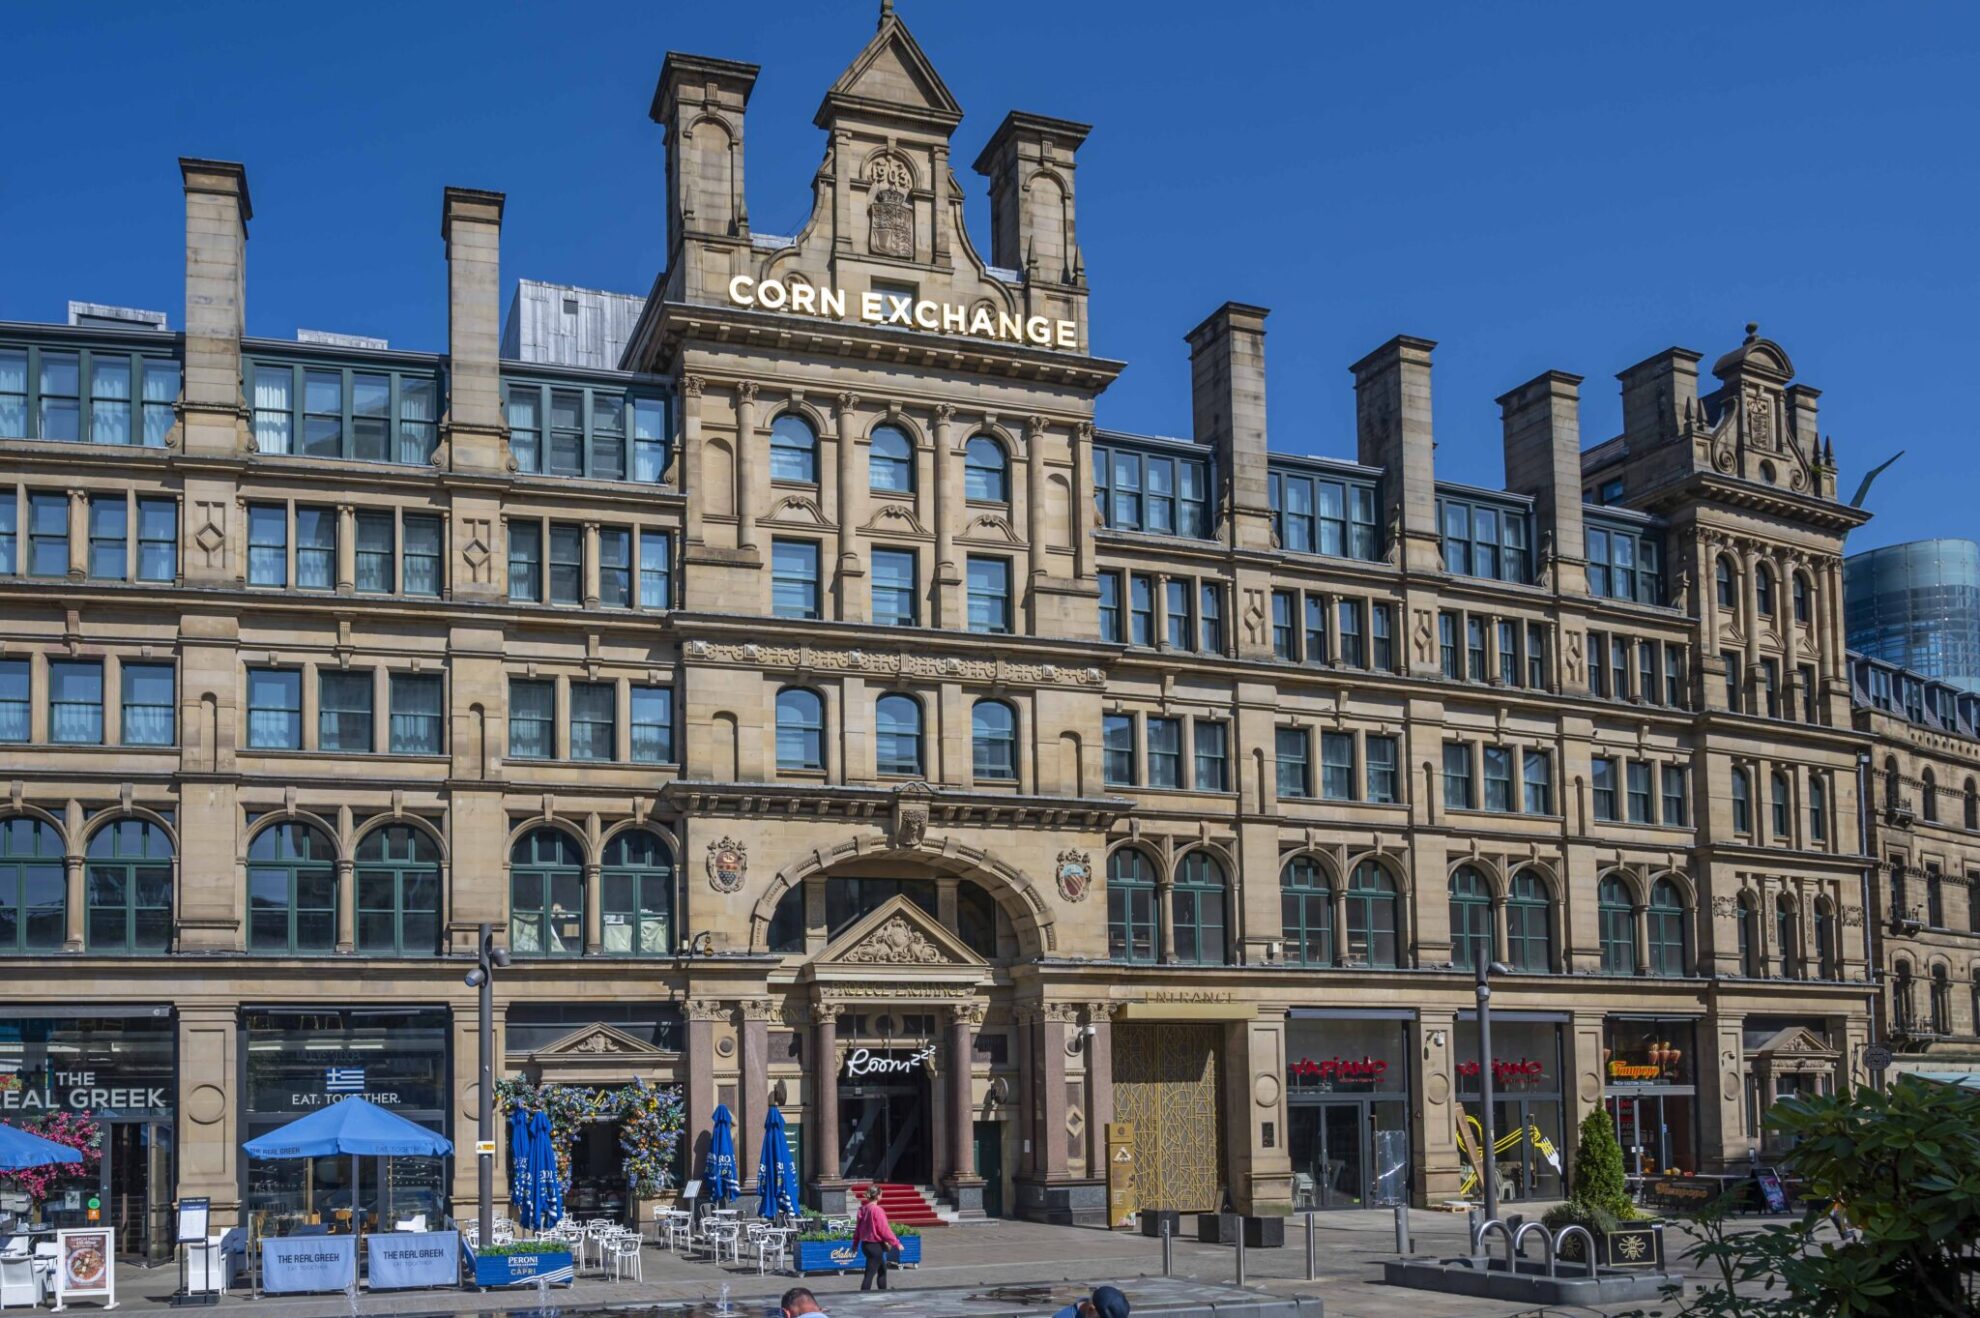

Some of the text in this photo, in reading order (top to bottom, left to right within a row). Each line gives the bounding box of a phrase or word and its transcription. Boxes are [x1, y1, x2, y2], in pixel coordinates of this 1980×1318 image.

[728, 275, 1076, 347] CORN EXCHANGE
[832, 982, 965, 997] PRODUCE EXCHANGE
[1145, 991, 1237, 1004] ENTRANCE
[1455, 1057, 1543, 1079] VAIANO
[56, 1072, 95, 1086] THE
[0, 1088, 166, 1109] EAL GREEK
[292, 1093, 401, 1105] EAT. TOGTHER.
[277, 1253, 340, 1264] THE REAL GREEK
[383, 1248, 444, 1259] THE REAL GREEK
[508, 1256, 538, 1264] PERONI
[510, 1268, 536, 1276] CAPRI
